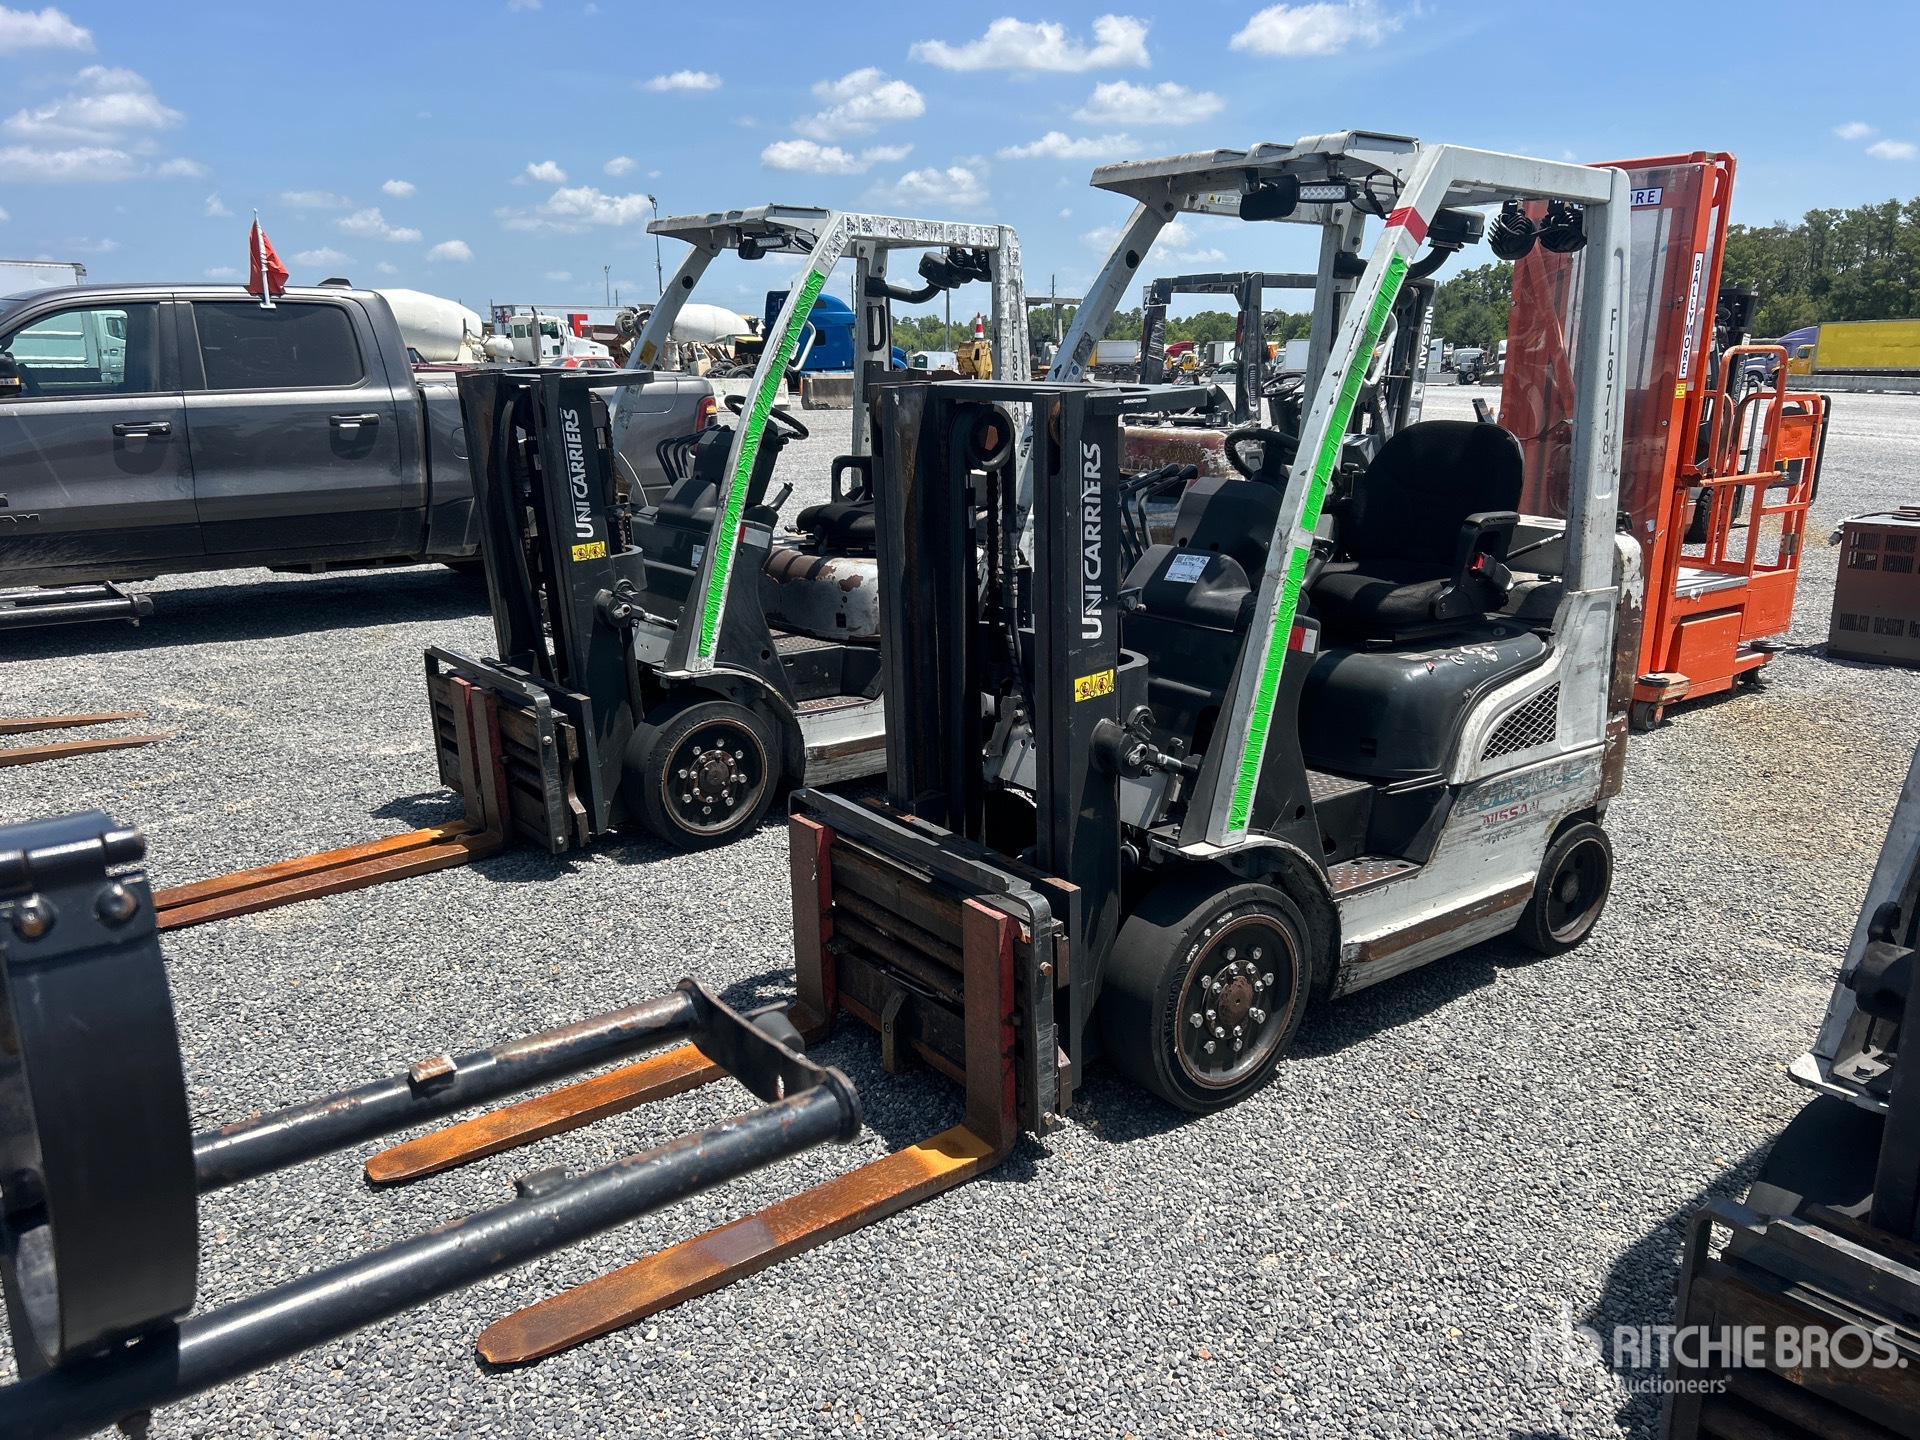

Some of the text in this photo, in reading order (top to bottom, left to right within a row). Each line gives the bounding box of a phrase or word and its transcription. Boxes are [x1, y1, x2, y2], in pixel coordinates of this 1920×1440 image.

[1418, 306, 1434, 369] NISSAN
[1602, 308, 1617, 455] FL8718
[1680, 259, 1701, 374] BALLYMORE
[560, 407, 594, 538] UNICARRIERS
[1080, 440, 1102, 639] UNICARRIERS
